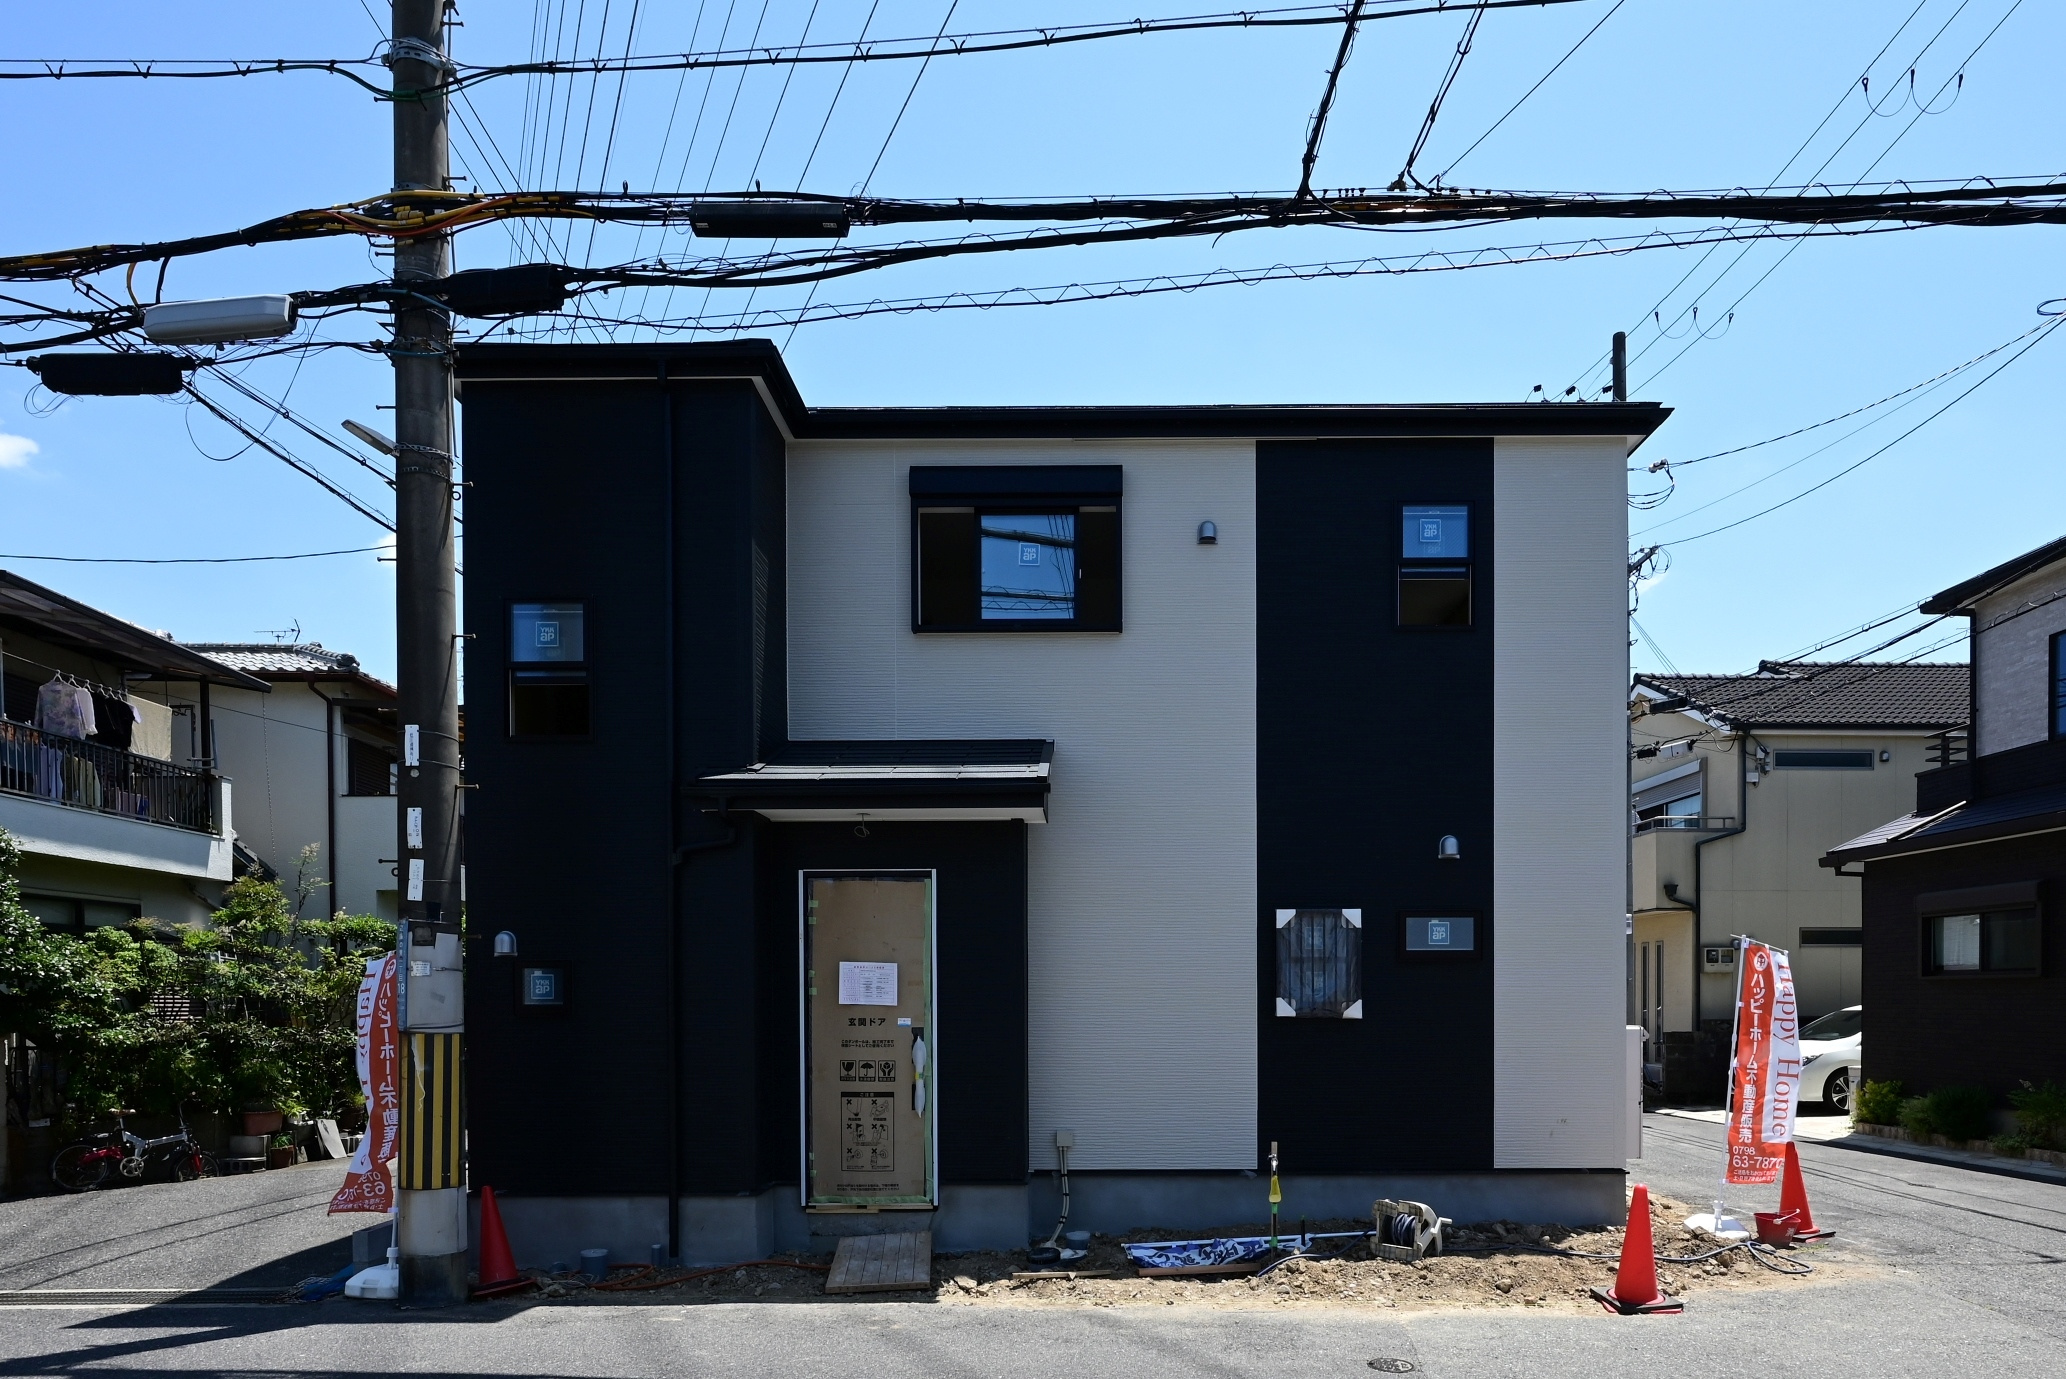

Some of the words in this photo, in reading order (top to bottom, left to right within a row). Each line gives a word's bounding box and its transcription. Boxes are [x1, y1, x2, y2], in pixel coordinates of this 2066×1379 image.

[1023, 552, 1037, 561] ap
[540, 633, 554, 642] ap
[1433, 931, 1446, 940] ap
[535, 985, 550, 994] ap
[1773, 962, 1796, 1046] Happy
[848, 1017, 886, 1027] 玄関ドア
[1739, 972, 1766, 1143] ハッピーホーム不動産販売
[1771, 1056, 1800, 1136] Home
[1732, 1145, 1756, 1155] 0798
[1732, 1155, 1784, 1169] 63-7870
